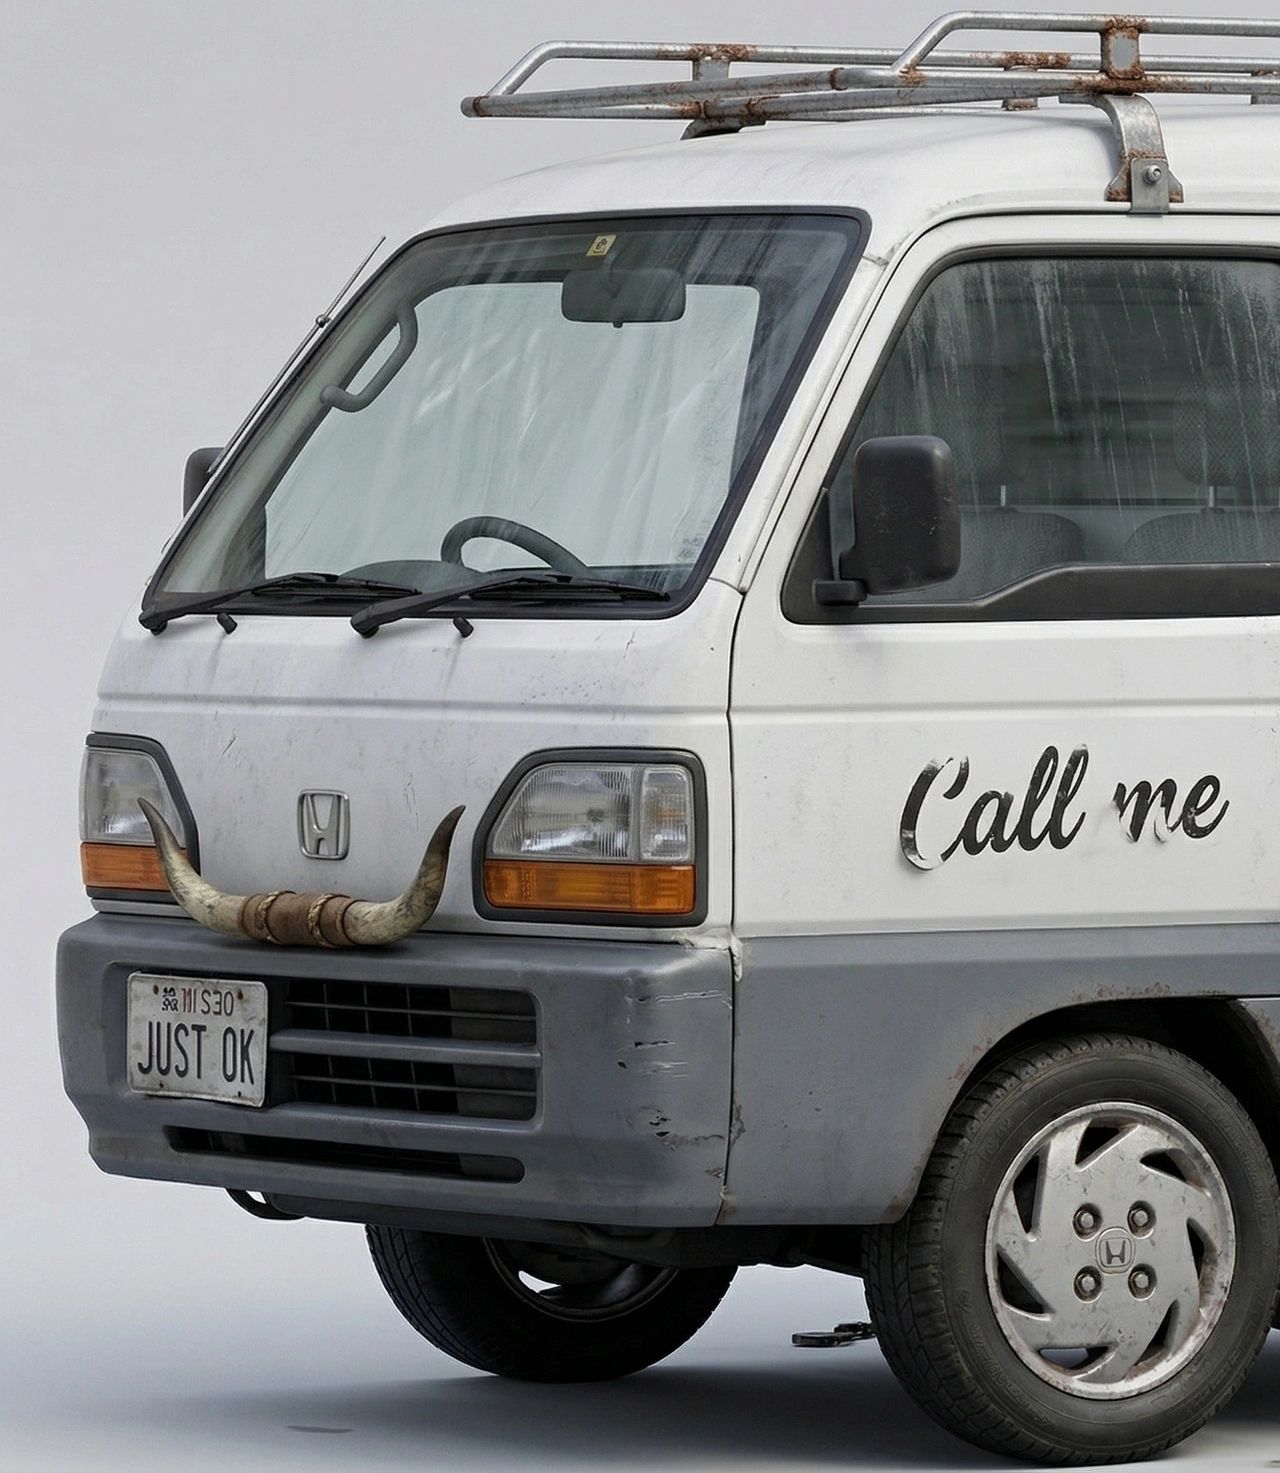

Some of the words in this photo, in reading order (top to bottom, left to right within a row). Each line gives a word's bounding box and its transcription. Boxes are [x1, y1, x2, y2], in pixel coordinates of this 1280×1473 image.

[899, 743, 1089, 871] Call
[1112, 774, 1230, 843] me
[137, 1021, 207, 1079] JUST
[222, 1026, 255, 1085] OK
